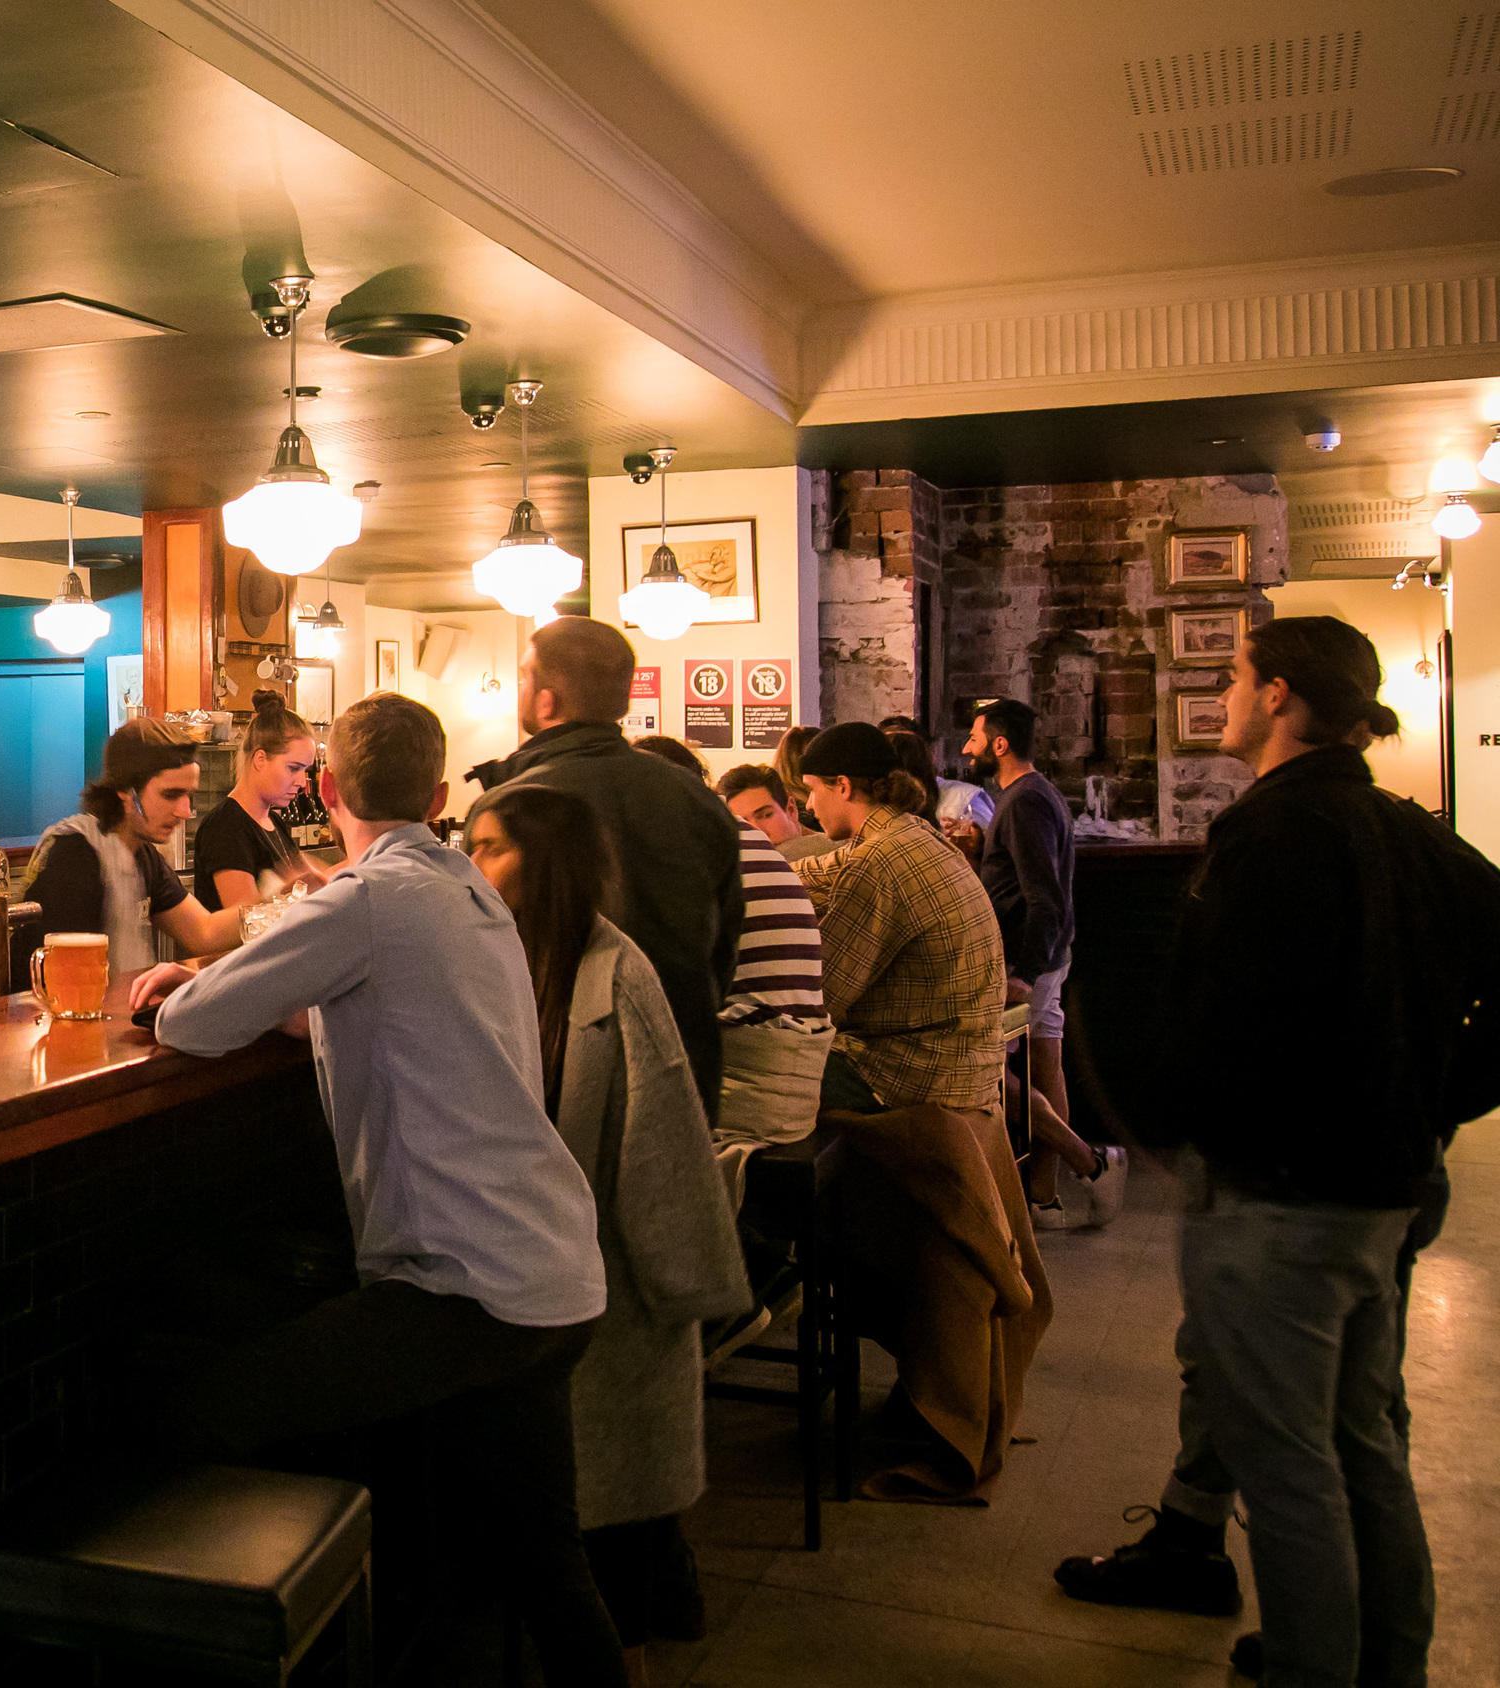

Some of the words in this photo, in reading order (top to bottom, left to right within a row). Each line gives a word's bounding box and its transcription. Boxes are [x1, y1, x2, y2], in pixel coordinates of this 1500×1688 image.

[640, 672, 654, 681] 25?
[699, 676, 718, 694] 18
[756, 676, 776, 694] 18
